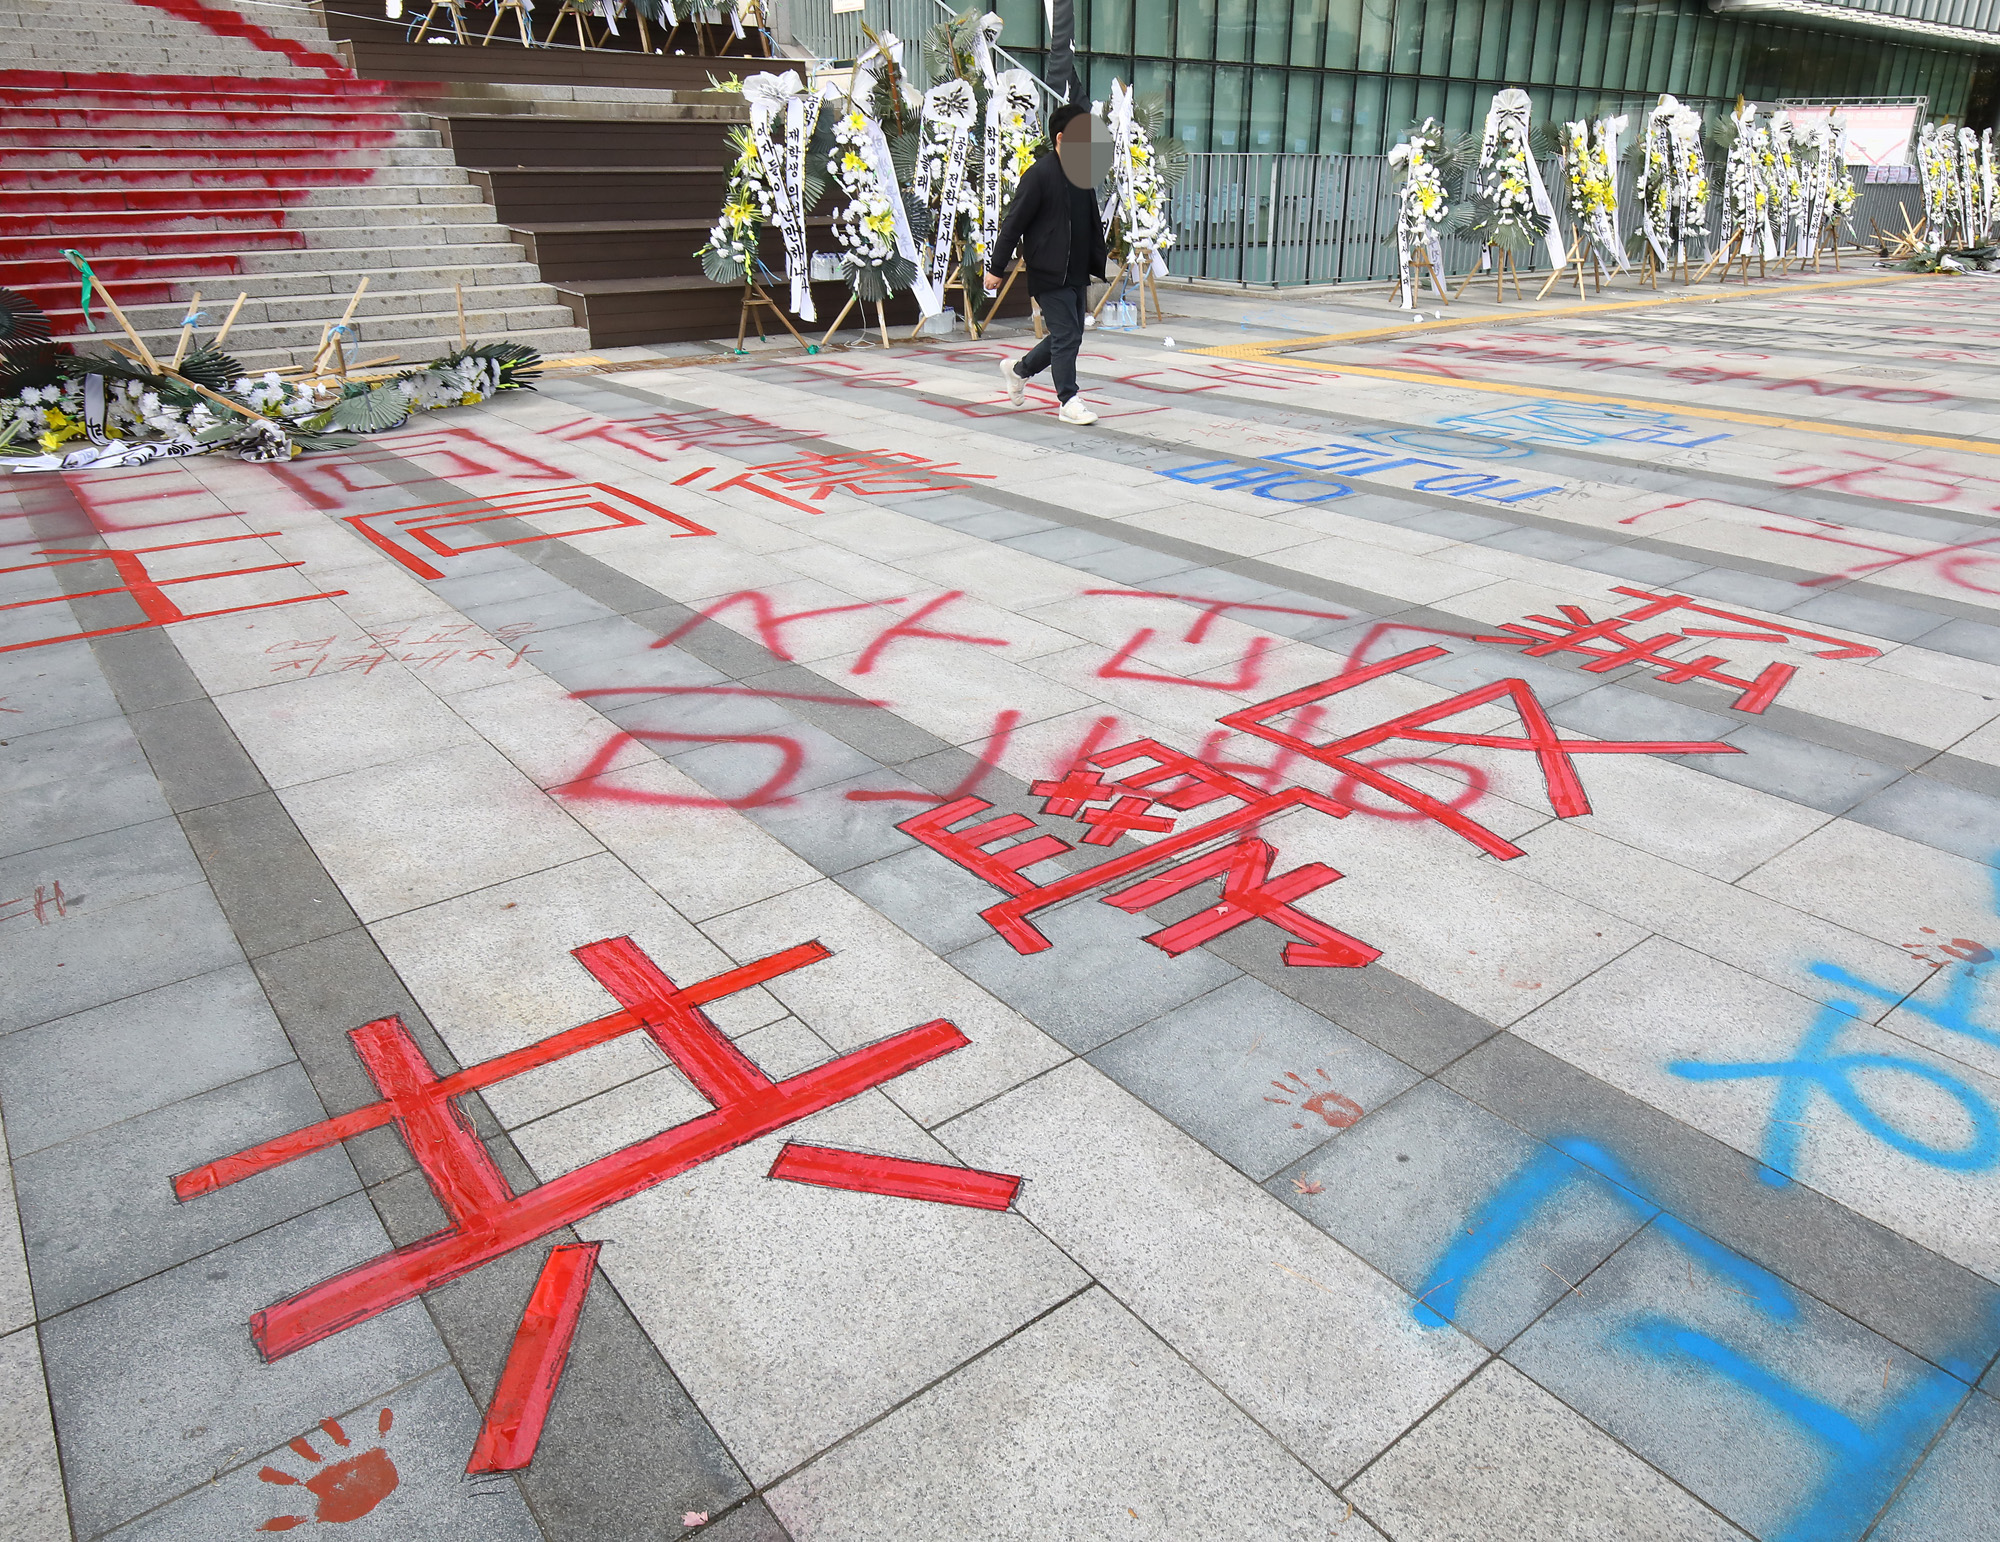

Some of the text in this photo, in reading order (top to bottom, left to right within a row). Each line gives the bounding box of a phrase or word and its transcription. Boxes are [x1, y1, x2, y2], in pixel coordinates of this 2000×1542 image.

[756, 122, 782, 192] 여자들이
[788, 128, 800, 178] 재학생
[986, 126, 998, 166] 학생
[933, 137, 967, 285] 공학 전환 결사 반대
[986, 172, 998, 211] 몰래
[1761, 379, 1956, 404] NO
[264, 622, 538, 655] 여성교육
[269, 644, 543, 678] 지켜내자
